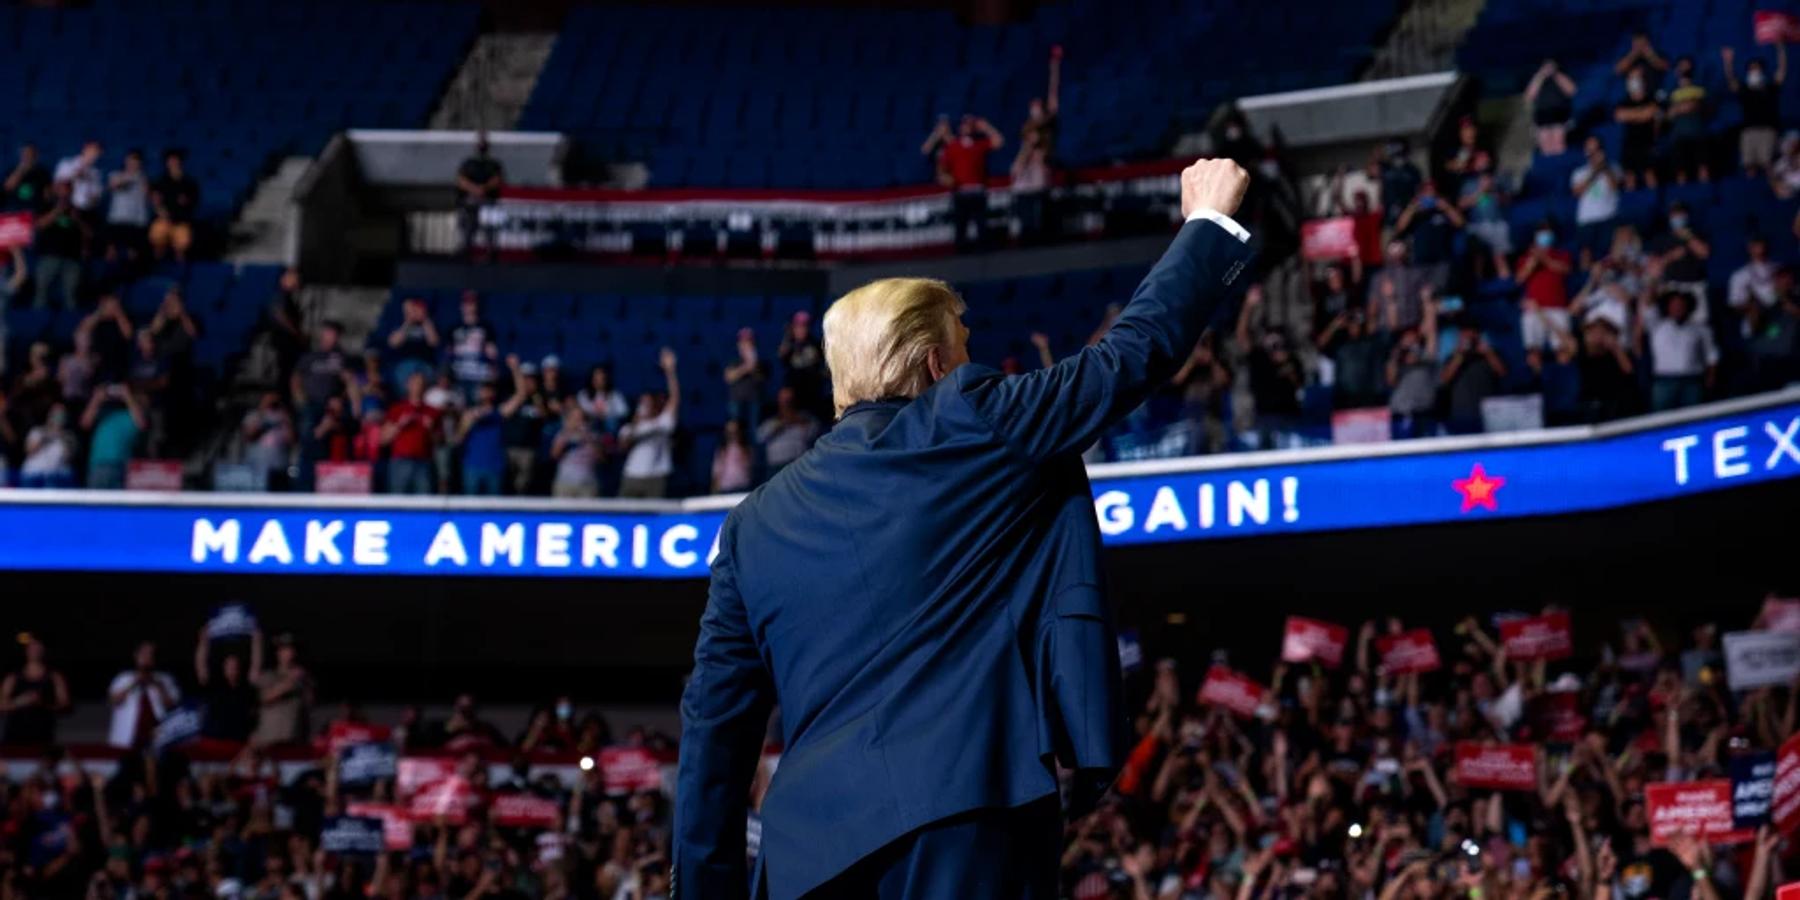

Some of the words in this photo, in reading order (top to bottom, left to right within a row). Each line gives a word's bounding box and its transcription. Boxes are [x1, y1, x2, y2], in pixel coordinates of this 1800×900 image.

[1662, 415, 1800, 486] TEX
[191, 518, 391, 565] MAKE
[1094, 476, 1299, 535] GAIN!
